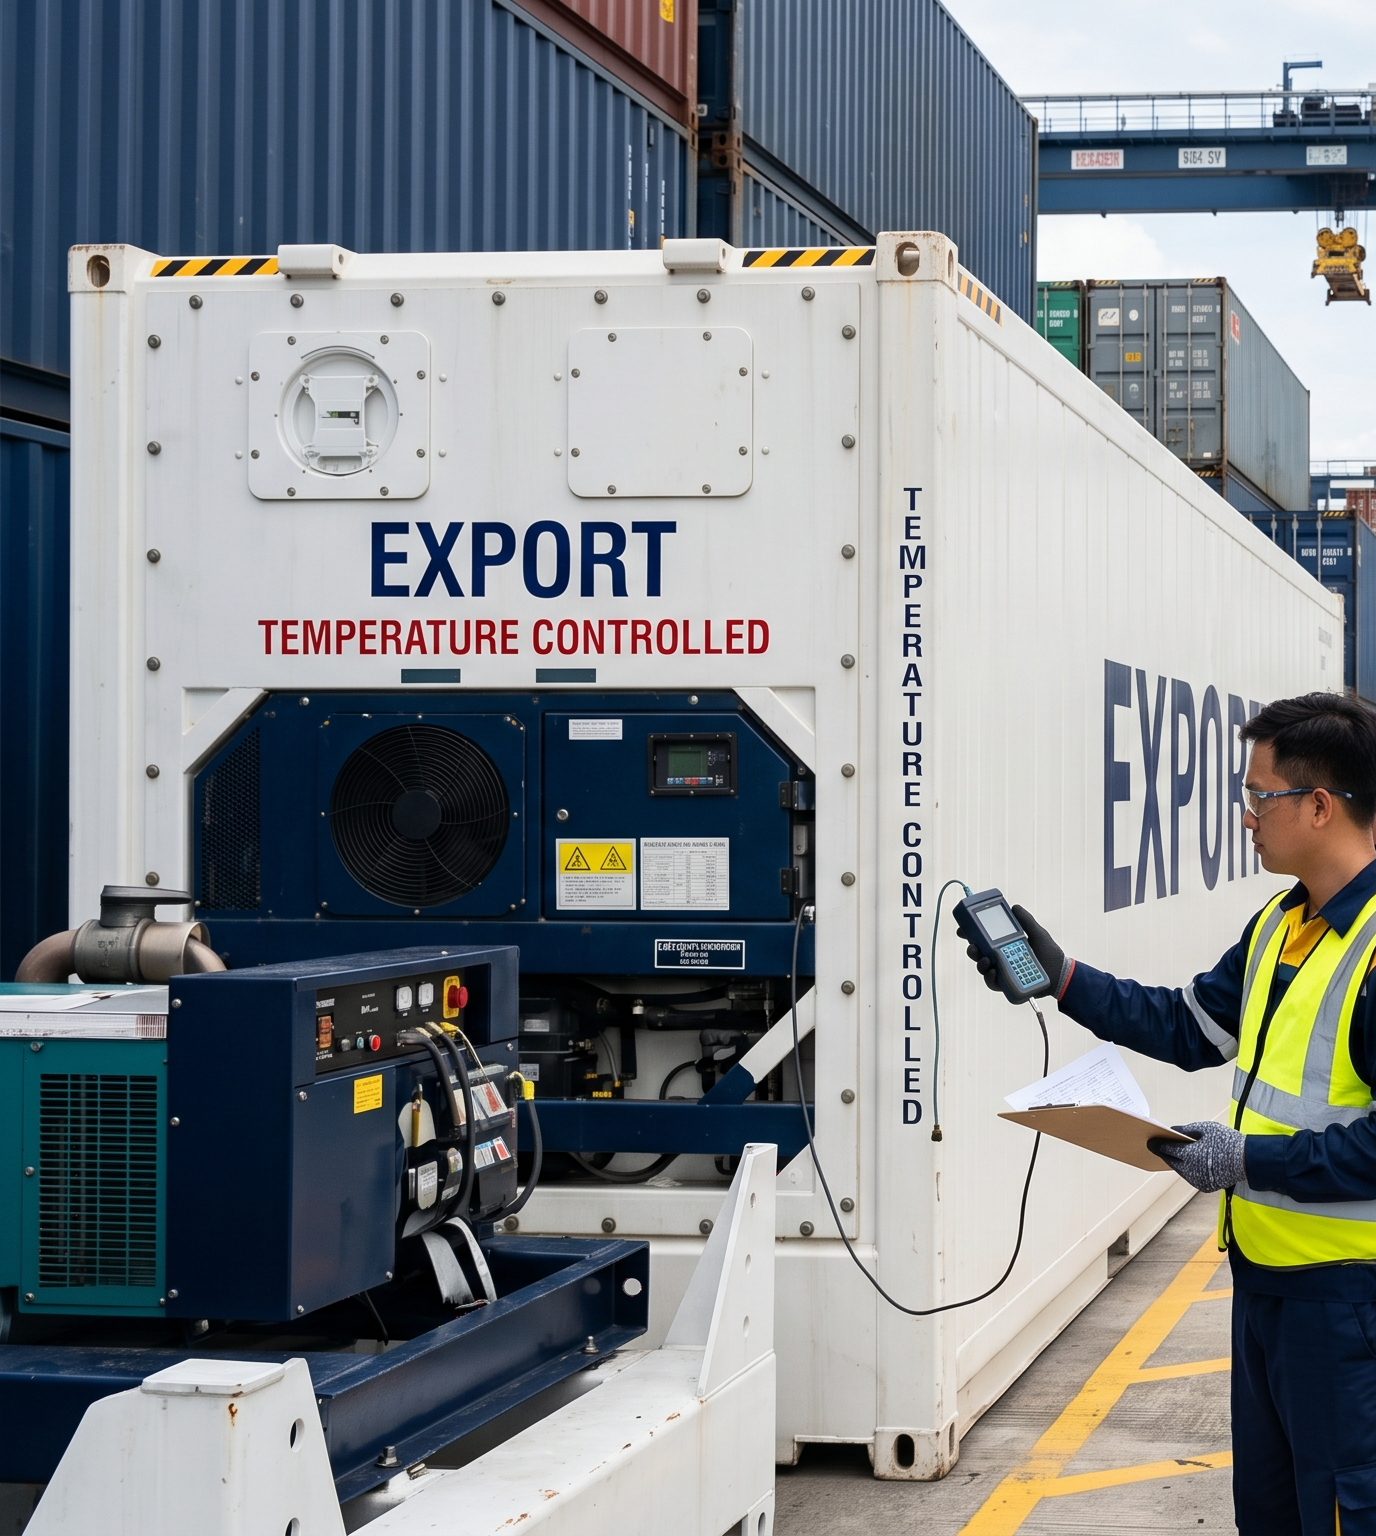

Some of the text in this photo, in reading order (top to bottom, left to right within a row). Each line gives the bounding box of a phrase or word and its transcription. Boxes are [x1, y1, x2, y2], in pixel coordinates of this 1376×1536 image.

[370, 520, 676, 598] EXPORT
[258, 619, 770, 656] TEMPERATURE CONTROLLED
[900, 487, 926, 1125] TEMPERATURE CONTROLLED
